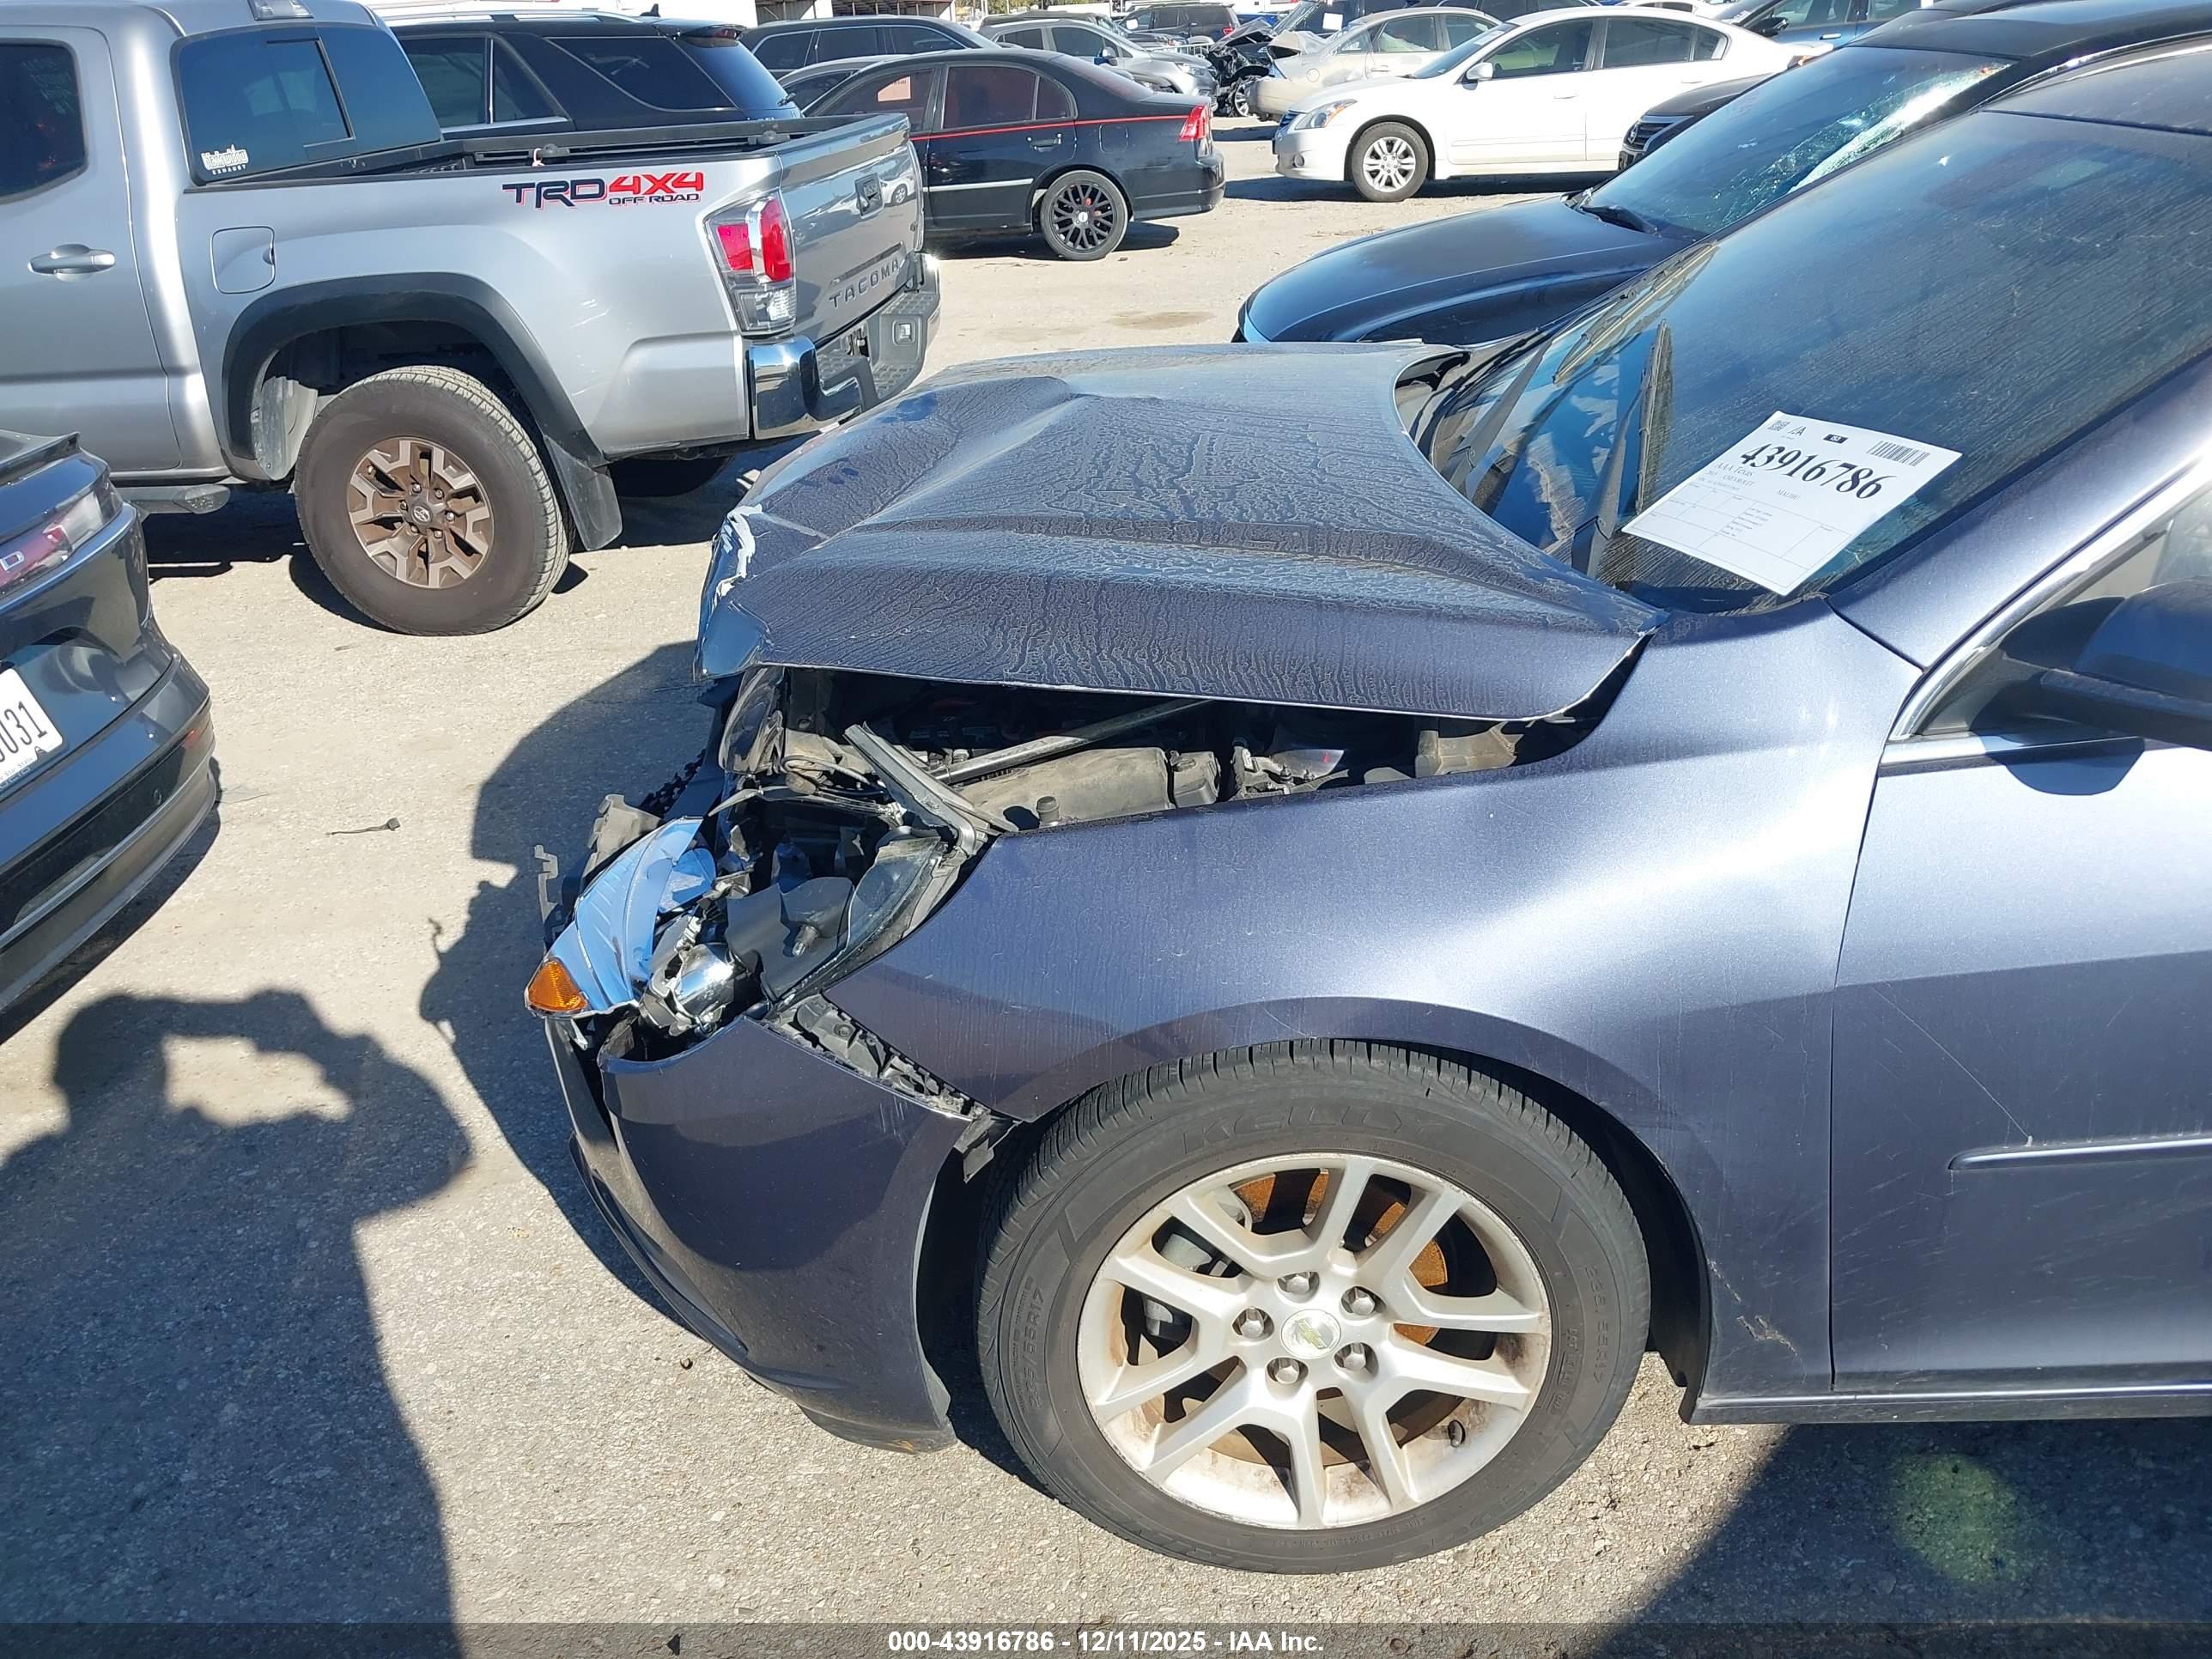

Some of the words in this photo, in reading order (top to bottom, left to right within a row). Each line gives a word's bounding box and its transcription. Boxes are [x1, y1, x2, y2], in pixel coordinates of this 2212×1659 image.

[502, 178, 607, 209] TRD
[609, 195, 644, 206] OFF
[648, 193, 701, 204] ROAD
[829, 258, 901, 309] TACOMA
[1739, 443, 1899, 500] 43916786
[0, 700, 48, 763] 031
